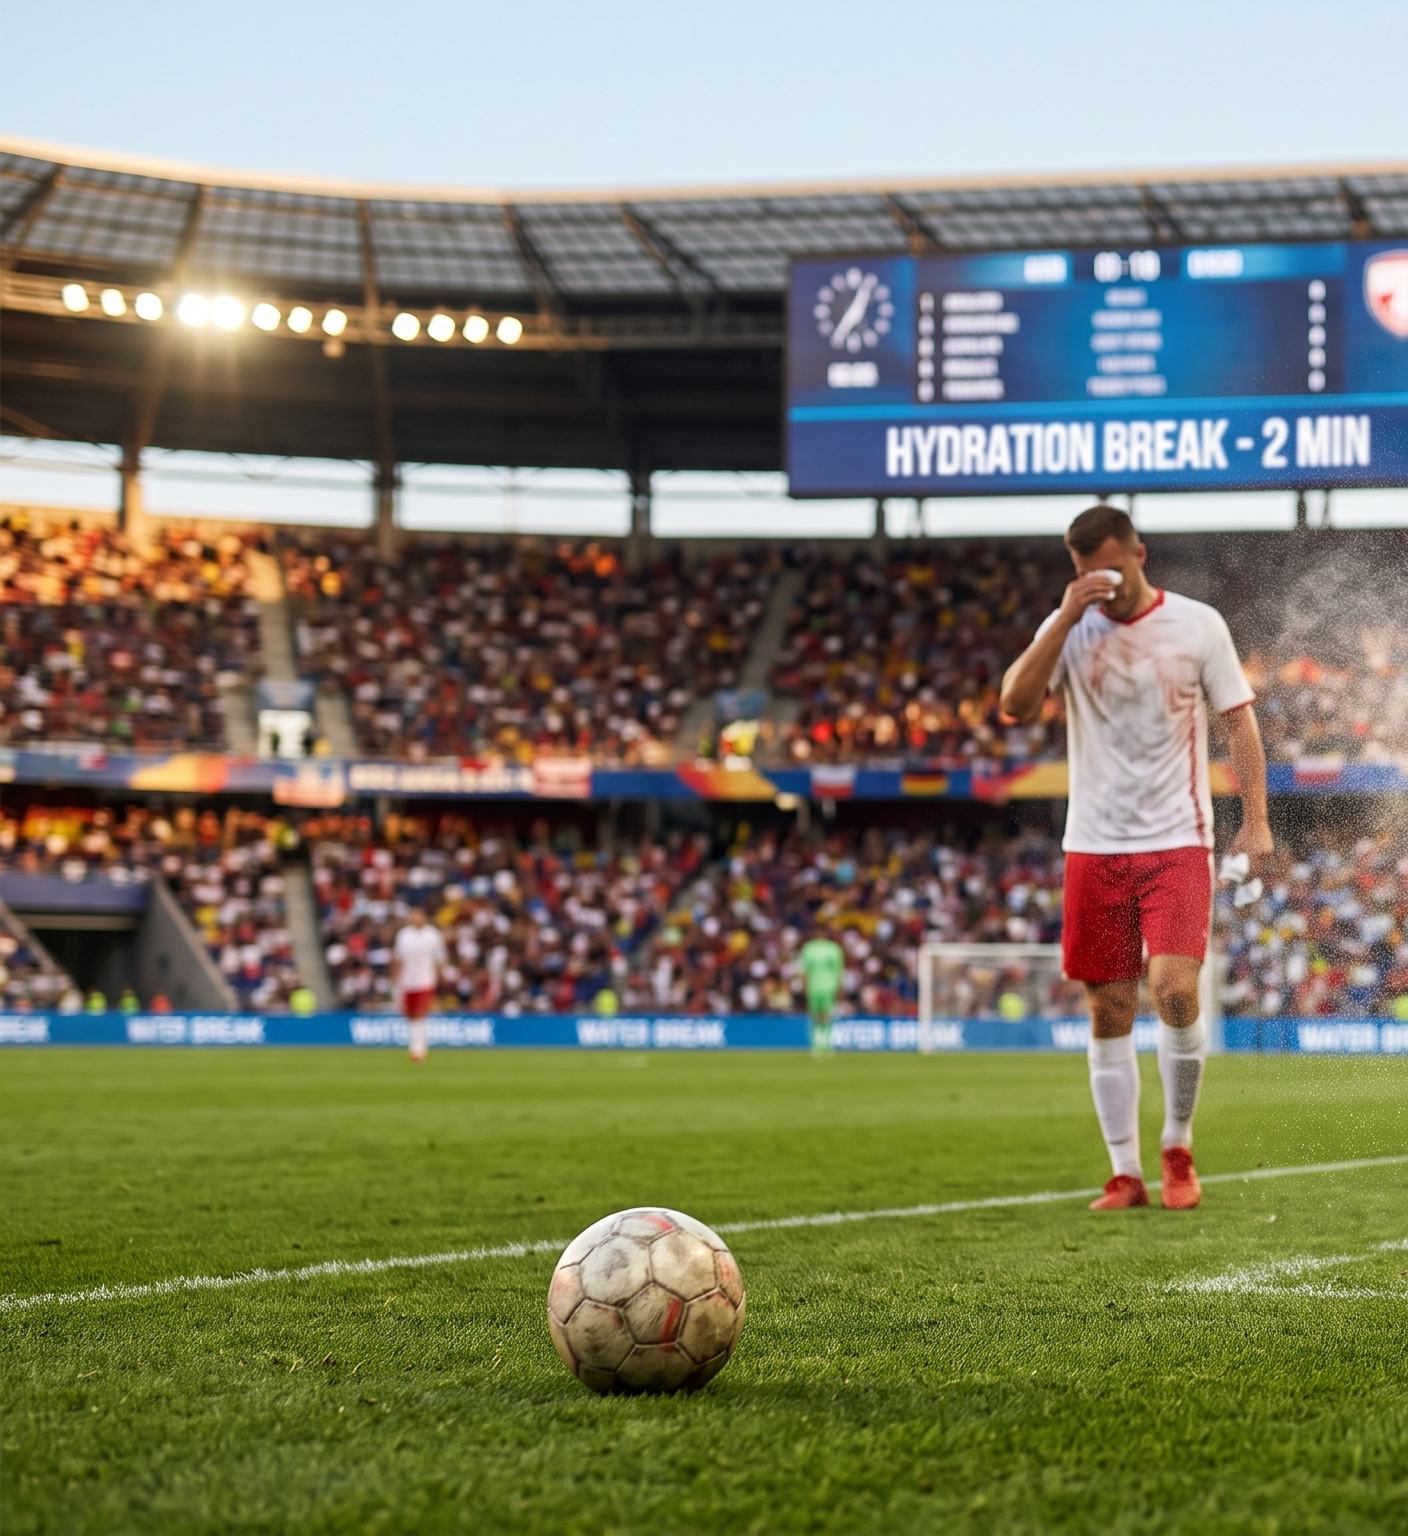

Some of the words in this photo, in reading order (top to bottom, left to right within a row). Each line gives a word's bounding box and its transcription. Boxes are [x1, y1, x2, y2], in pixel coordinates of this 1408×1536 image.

[886, 422, 1095, 476] HYDRATION
[1103, 419, 1229, 473] BREAK
[1235, 436, 1254, 450] -
[1261, 417, 1288, 468] 2
[1297, 415, 1370, 467] MIN
[576, 1018, 649, 1047] WATER
[652, 1018, 727, 1047] BREAK
[889, 1020, 965, 1049] BRAK
[1299, 1023, 1377, 1052] WATER
